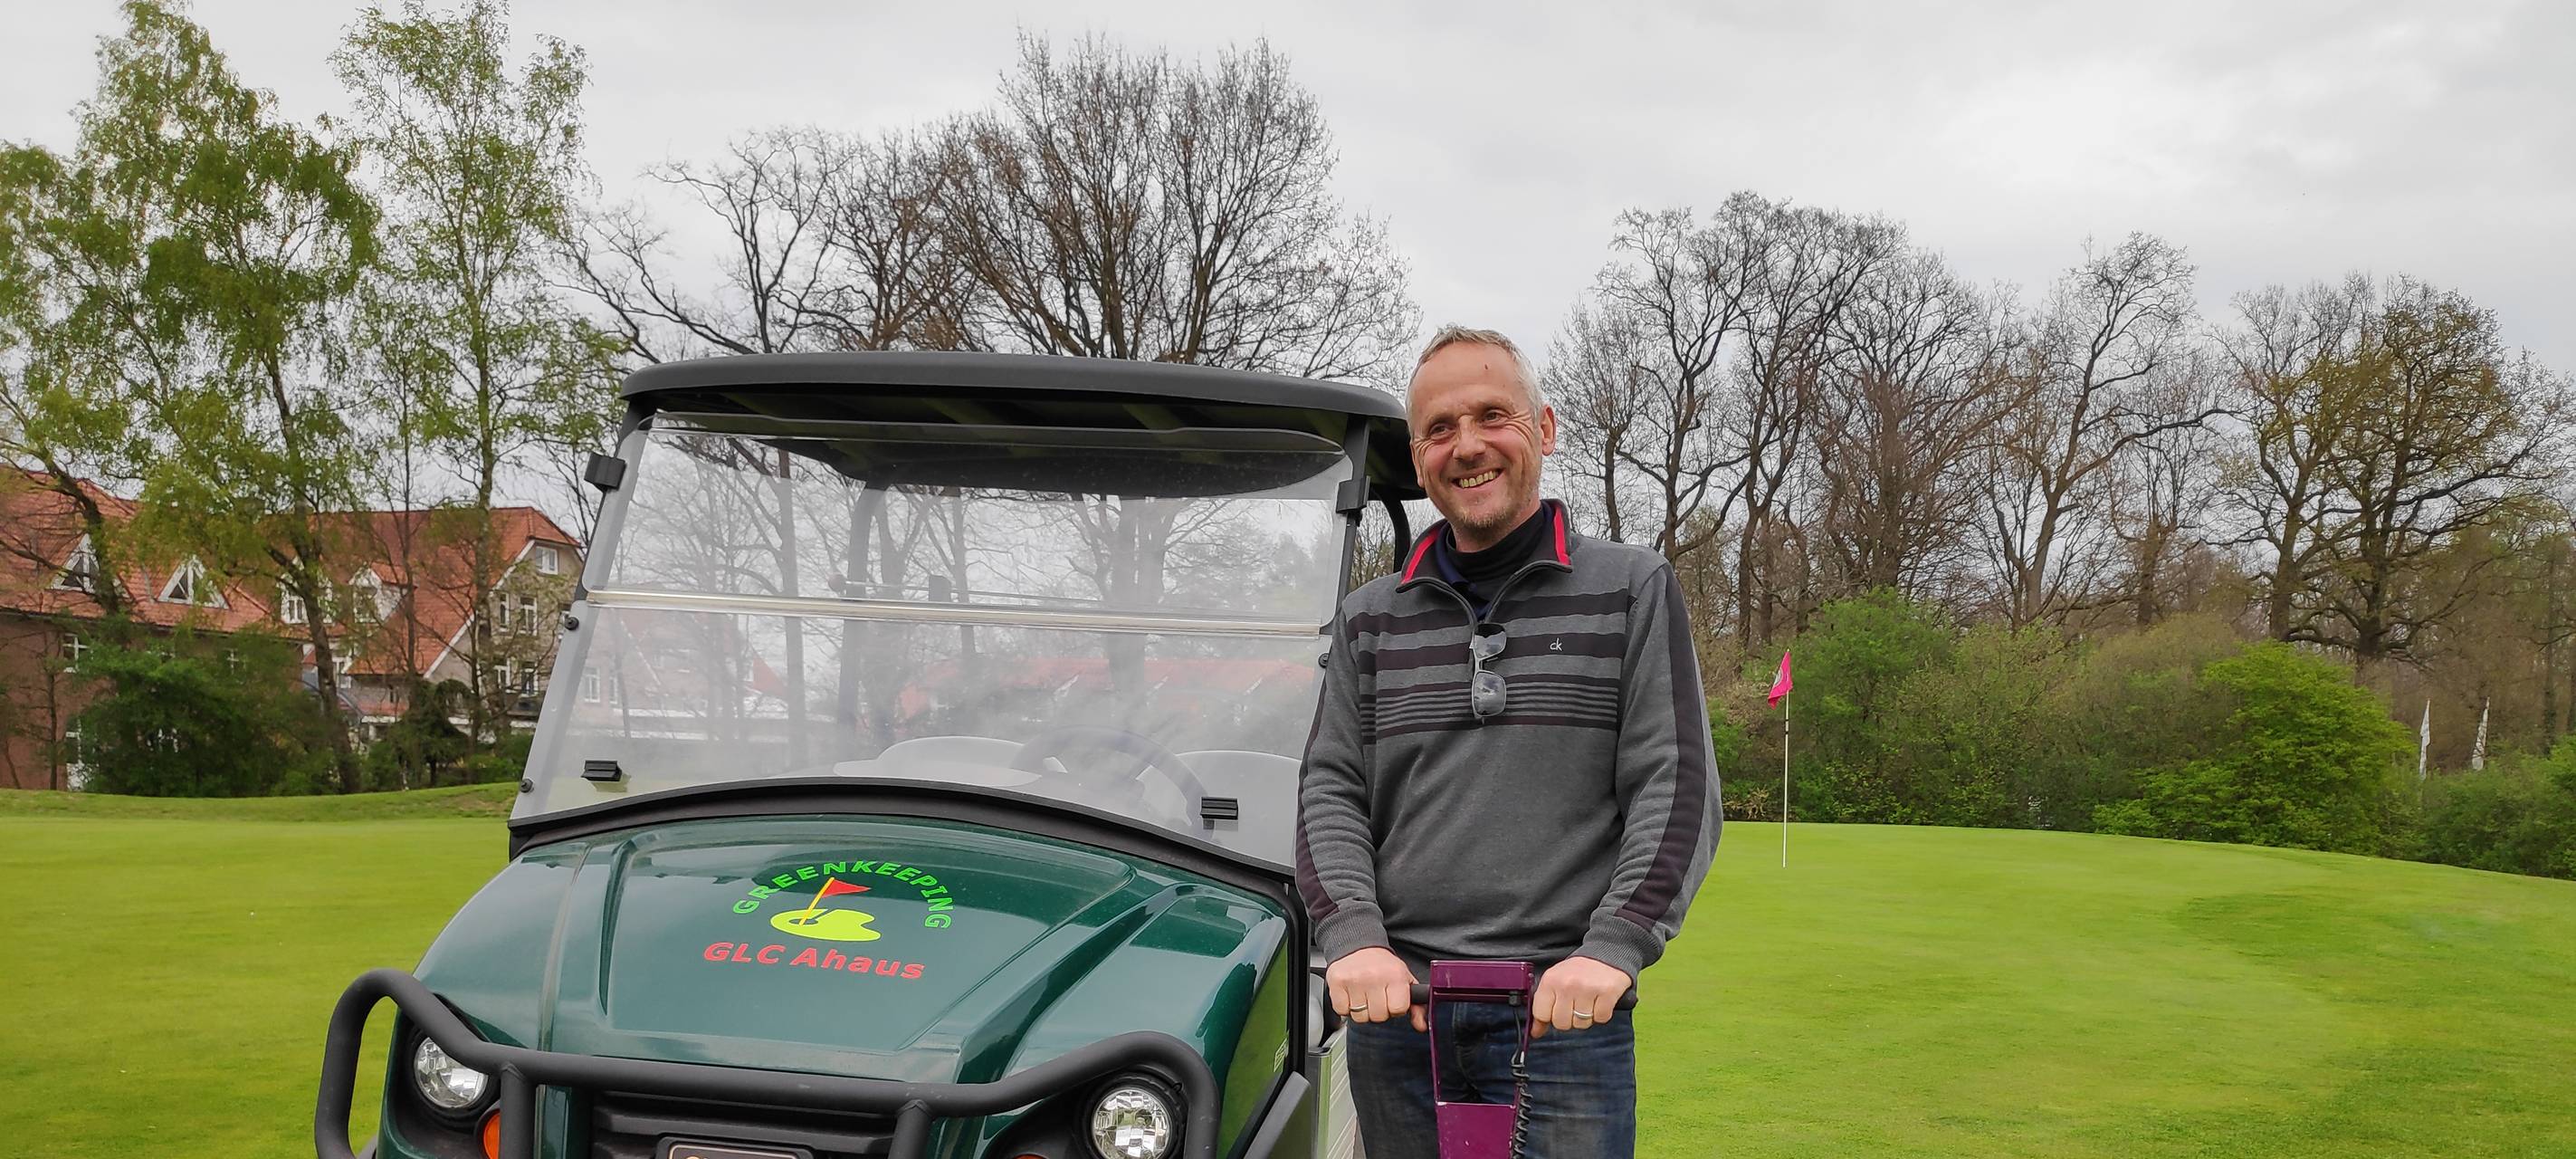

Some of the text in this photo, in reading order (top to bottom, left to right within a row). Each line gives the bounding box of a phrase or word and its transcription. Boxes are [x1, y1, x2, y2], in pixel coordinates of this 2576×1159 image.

[1550, 637, 1562, 651] ck
[733, 860, 954, 928] GREENKEEPING
[703, 942, 925, 979] GLC Ahaus
